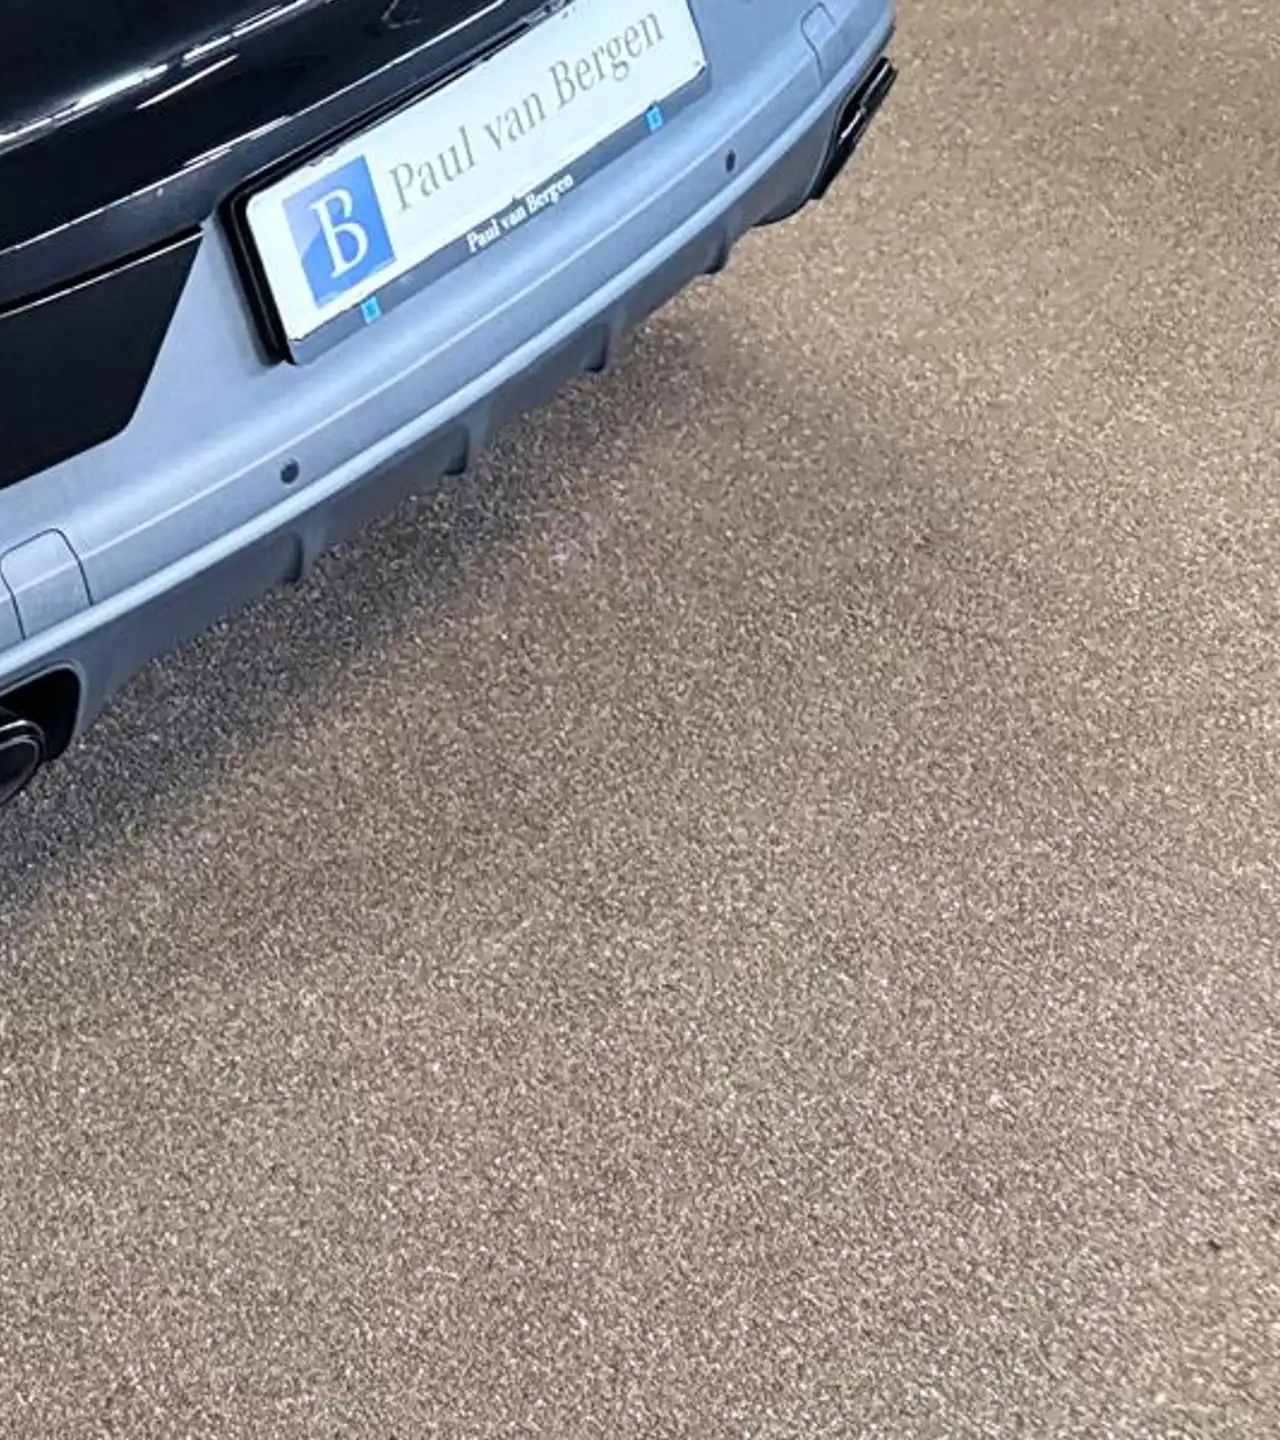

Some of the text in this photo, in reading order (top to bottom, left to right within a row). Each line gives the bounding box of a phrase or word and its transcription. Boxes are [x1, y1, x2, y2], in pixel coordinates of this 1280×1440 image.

[388, 10, 665, 212] Paul van Bergen
[309, 188, 369, 279] B
[465, 173, 574, 254] Paul van Bergen
